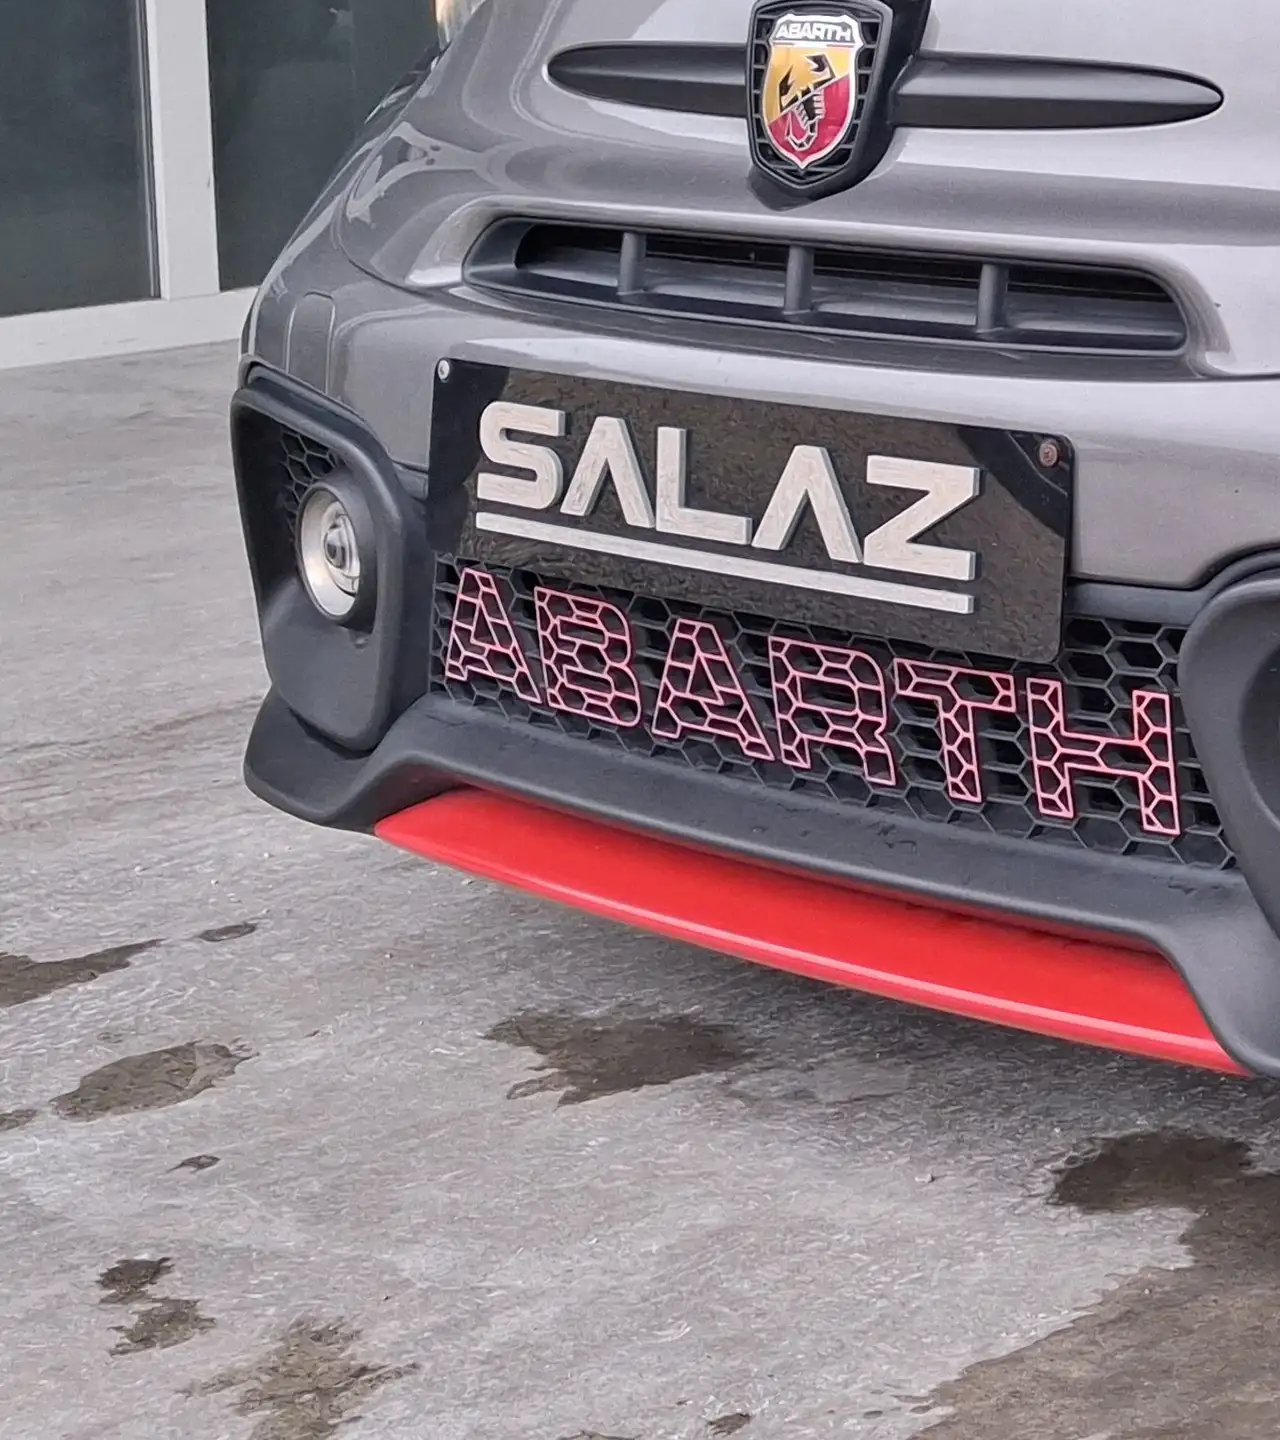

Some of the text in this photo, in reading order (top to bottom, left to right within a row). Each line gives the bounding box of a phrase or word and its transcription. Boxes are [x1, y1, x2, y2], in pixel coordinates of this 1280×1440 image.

[776, 22, 852, 42] ABARTH
[476, 401, 982, 582] SALAZ
[443, 567, 1181, 837] ABARTH
